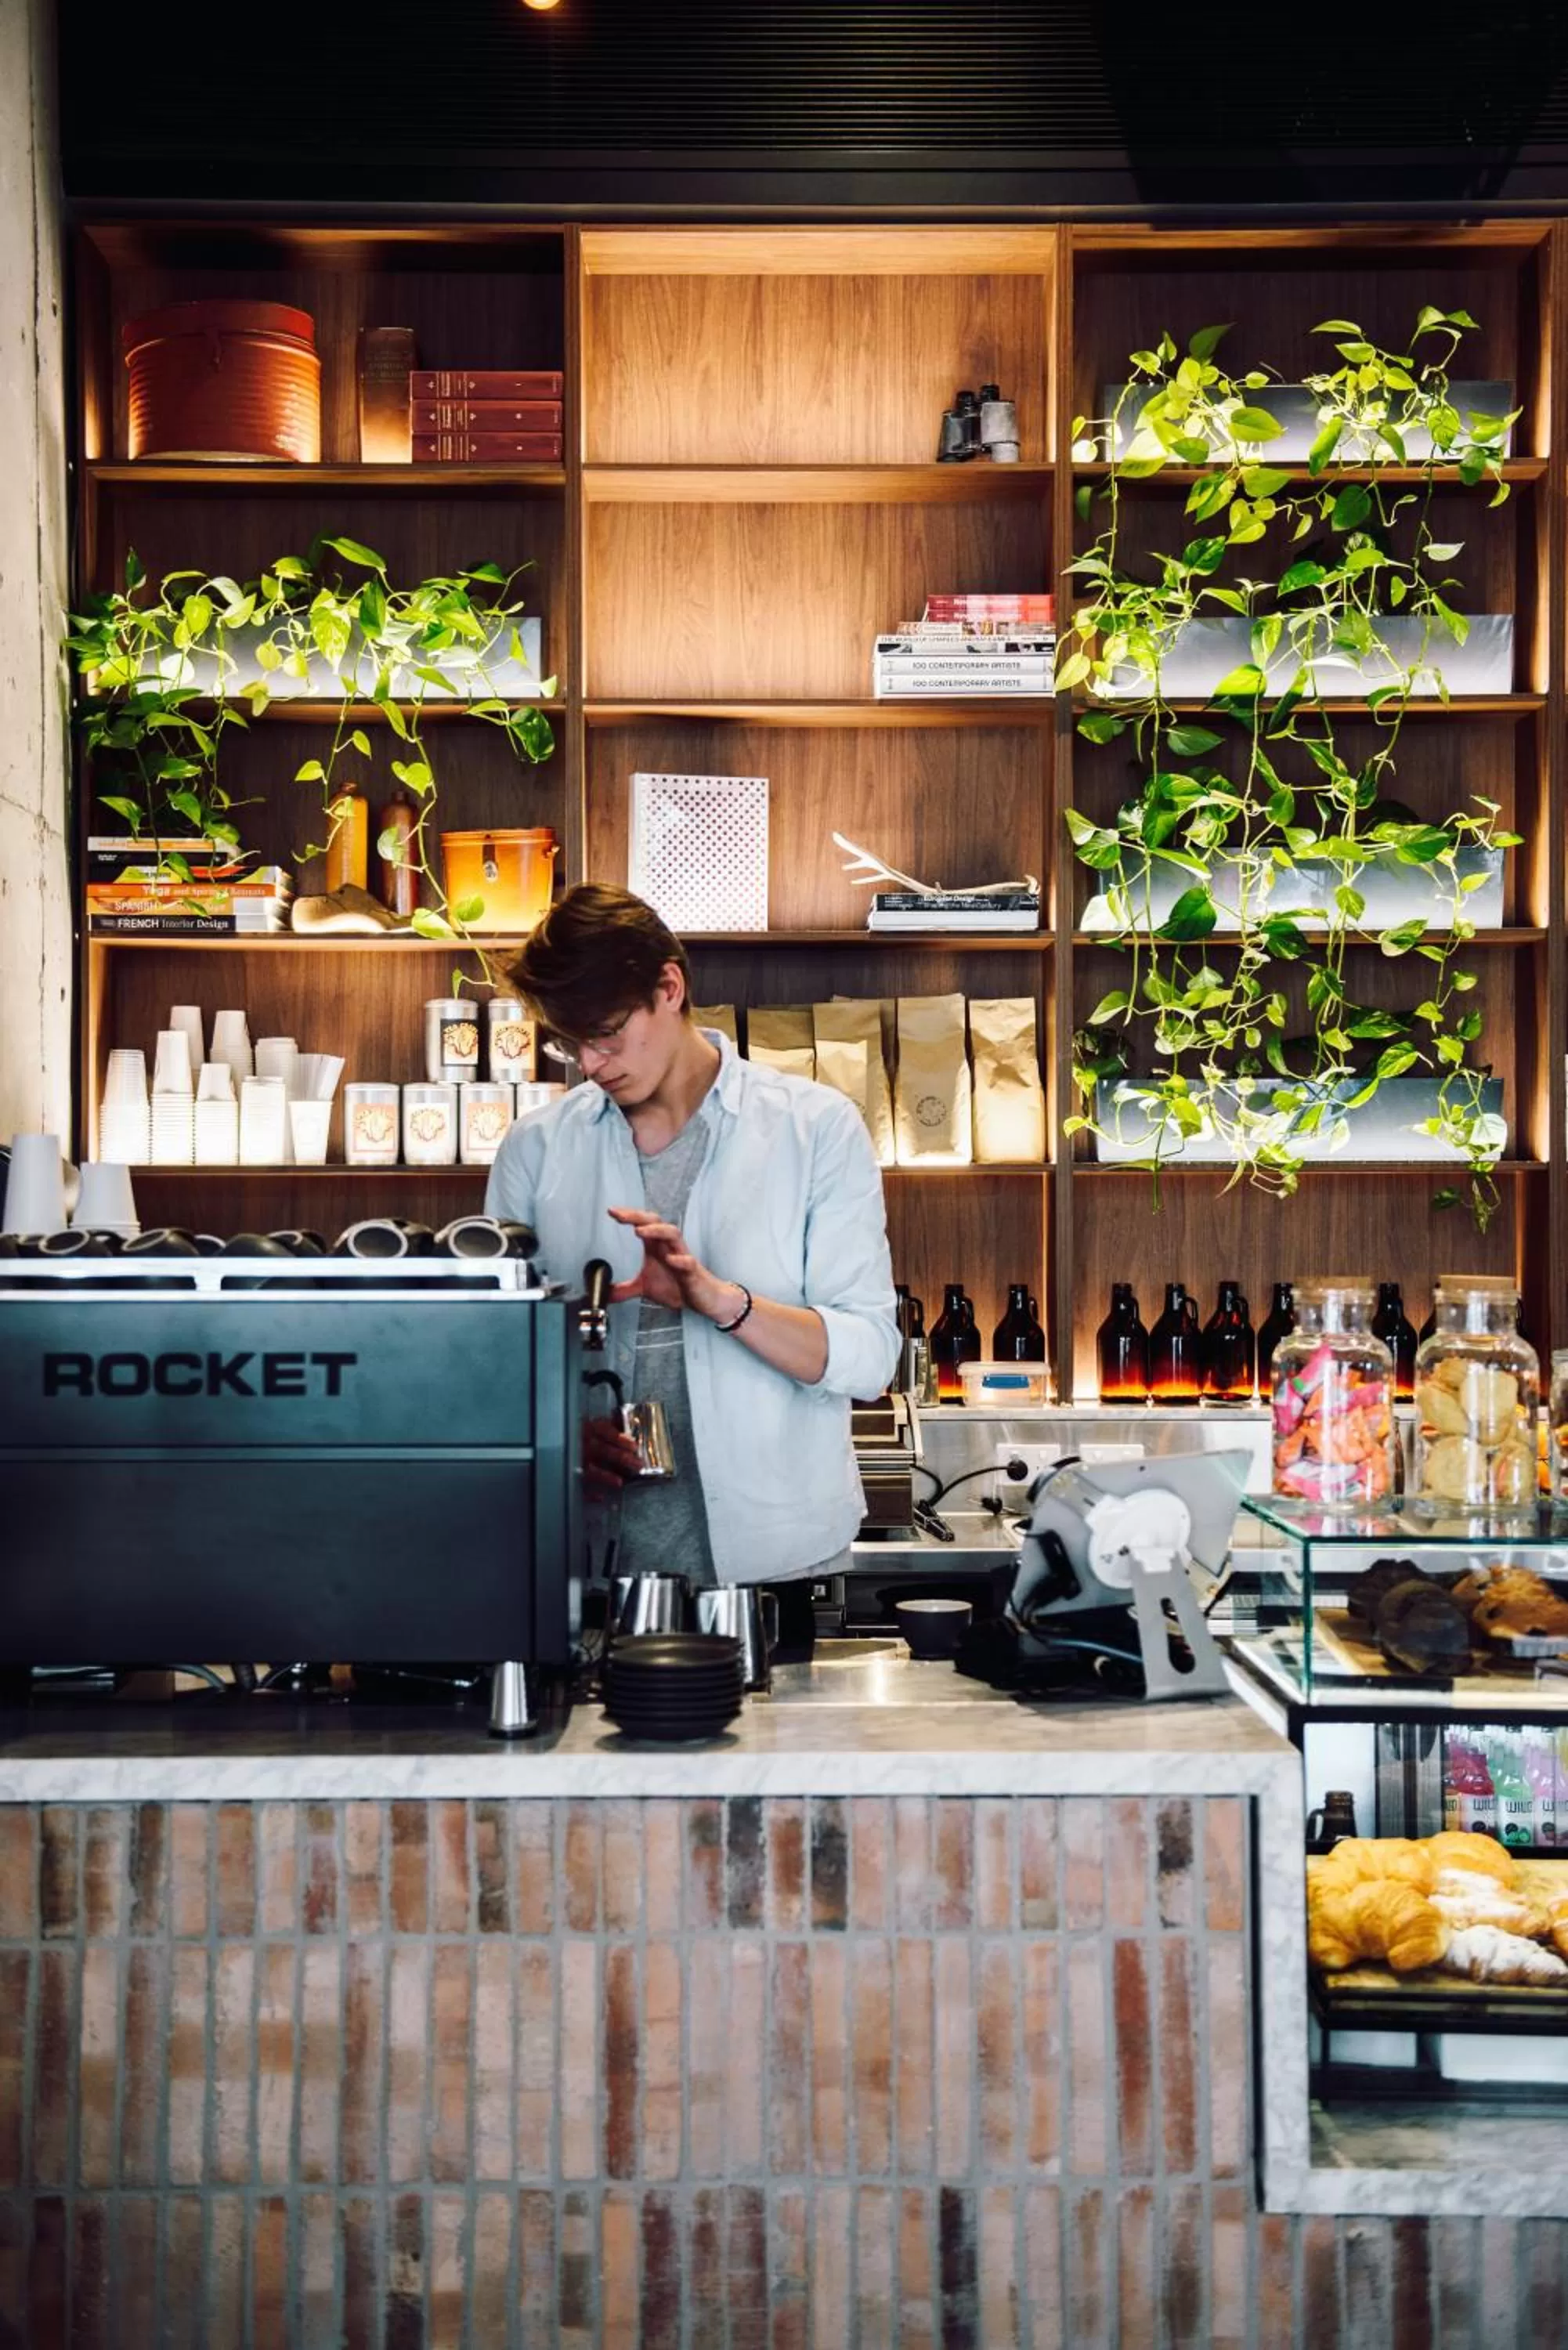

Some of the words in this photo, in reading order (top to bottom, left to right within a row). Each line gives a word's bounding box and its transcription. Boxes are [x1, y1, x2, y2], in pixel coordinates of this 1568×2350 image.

[117, 919, 160, 929] FRENCH
[162, 919, 195, 928] Interior
[197, 919, 229, 930] Design
[42, 1351, 357, 1397] ROCKET
